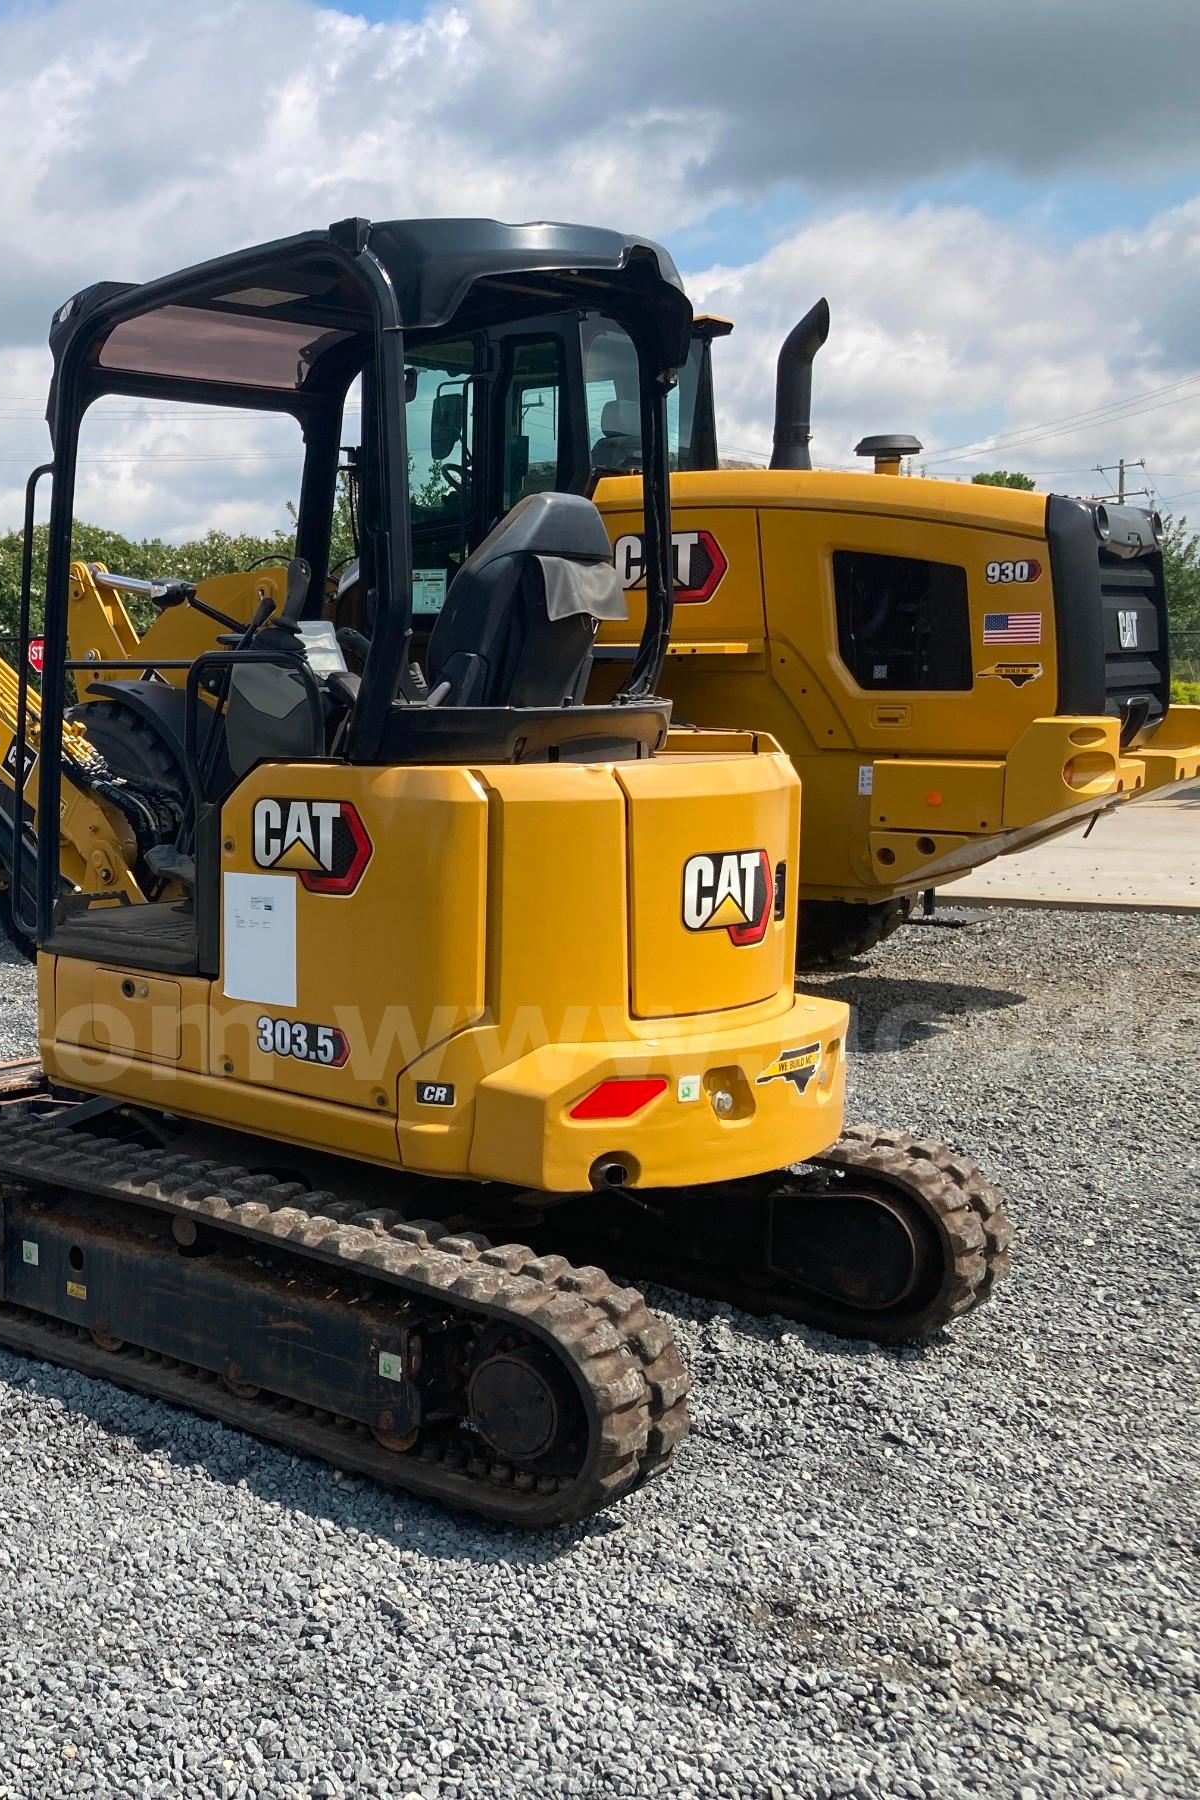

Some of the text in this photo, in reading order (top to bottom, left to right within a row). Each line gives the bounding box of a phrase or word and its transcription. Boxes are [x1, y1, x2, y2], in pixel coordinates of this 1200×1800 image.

[615, 532, 699, 589] CT
[987, 561, 1029, 583] 930
[1117, 610, 1138, 648] CAT
[7, 745, 32, 773] CT
[253, 797, 342, 873] CAT
[683, 850, 762, 930] CAT
[257, 1016, 337, 1064] 303.5
[778, 1054, 813, 1072] WE BUILD NC
[421, 1085, 449, 1104] CR
